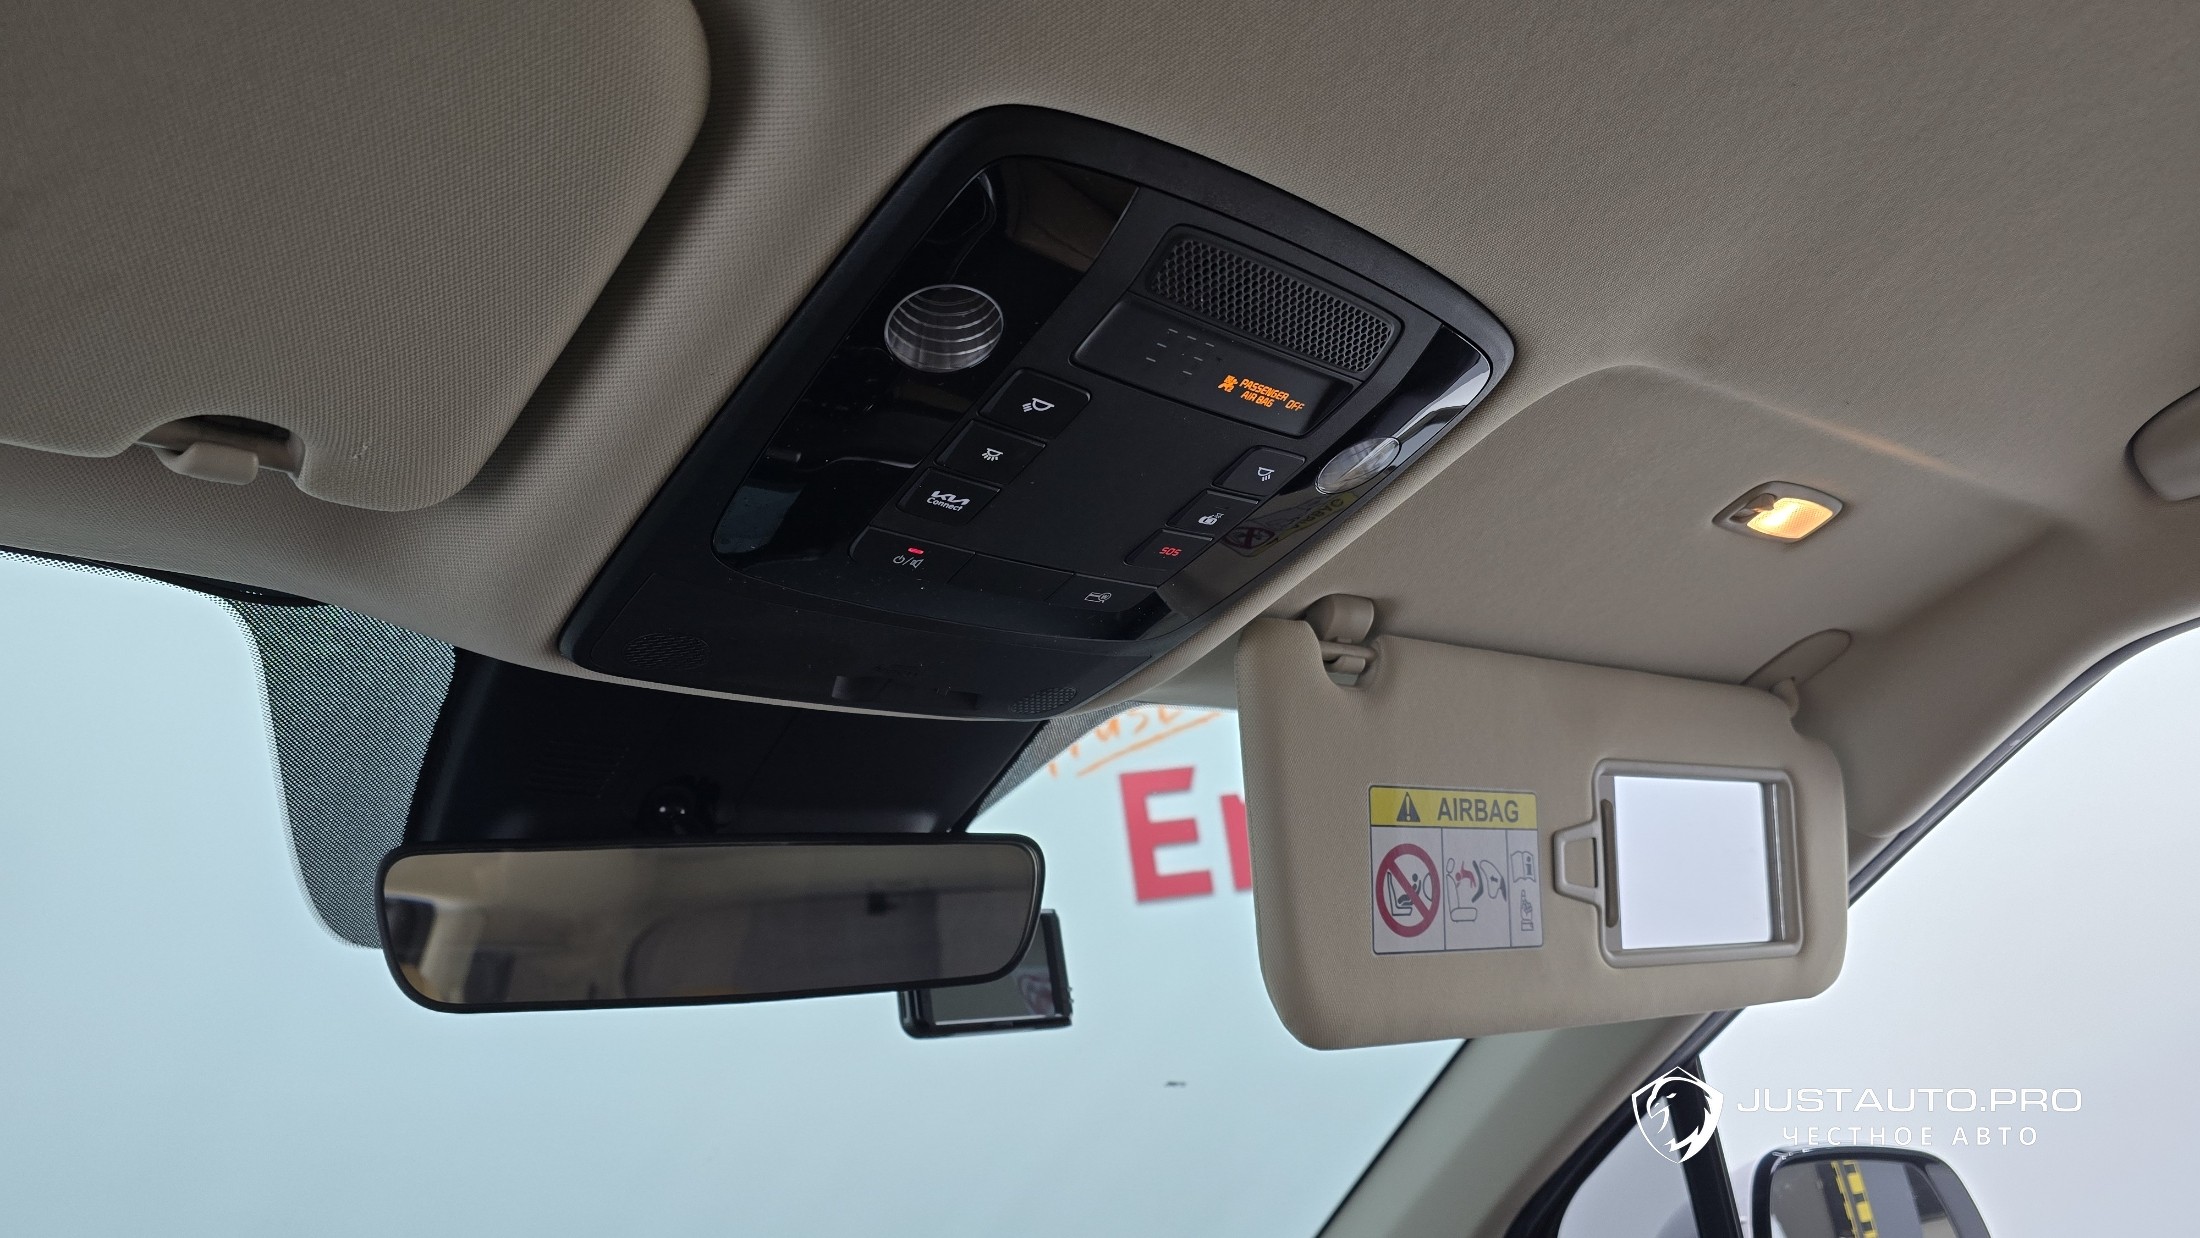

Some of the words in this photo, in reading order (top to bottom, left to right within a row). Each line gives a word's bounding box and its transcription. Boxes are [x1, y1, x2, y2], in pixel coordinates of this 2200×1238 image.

[1239, 379, 1290, 401] PASSENGER
[1285, 400, 1305, 411] OFF
[926, 497, 964, 512] Connect
[1159, 546, 1182, 557] SOS
[1437, 797, 1519, 824] AIRBAG
